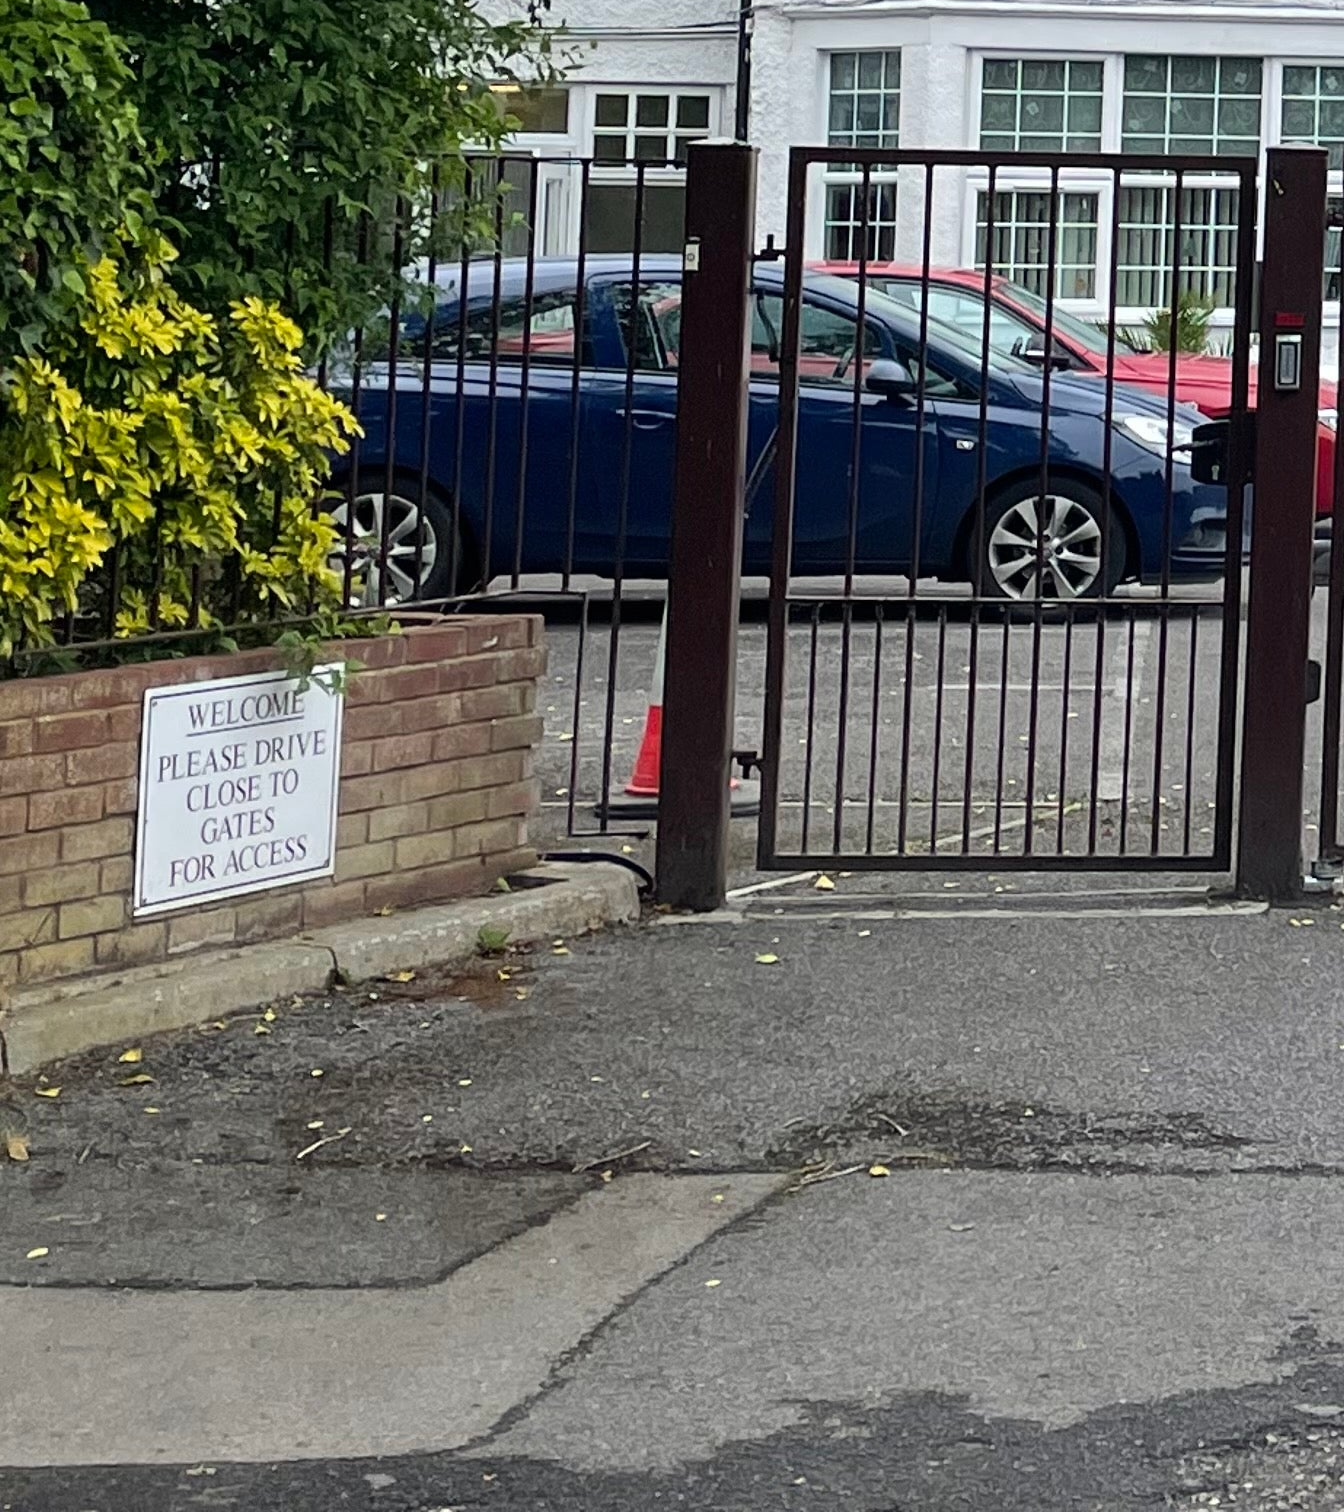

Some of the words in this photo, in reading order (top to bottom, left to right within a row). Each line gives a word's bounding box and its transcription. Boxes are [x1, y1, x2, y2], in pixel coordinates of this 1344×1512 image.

[187, 689, 305, 729] WELCOME
[157, 742, 247, 784] PLEASE
[255, 729, 327, 766] DRIVE
[186, 774, 262, 813] CLOSE
[269, 768, 299, 798] TO
[200, 805, 276, 846] GATES
[168, 853, 216, 888] FOR
[222, 833, 308, 877] ACCESS
